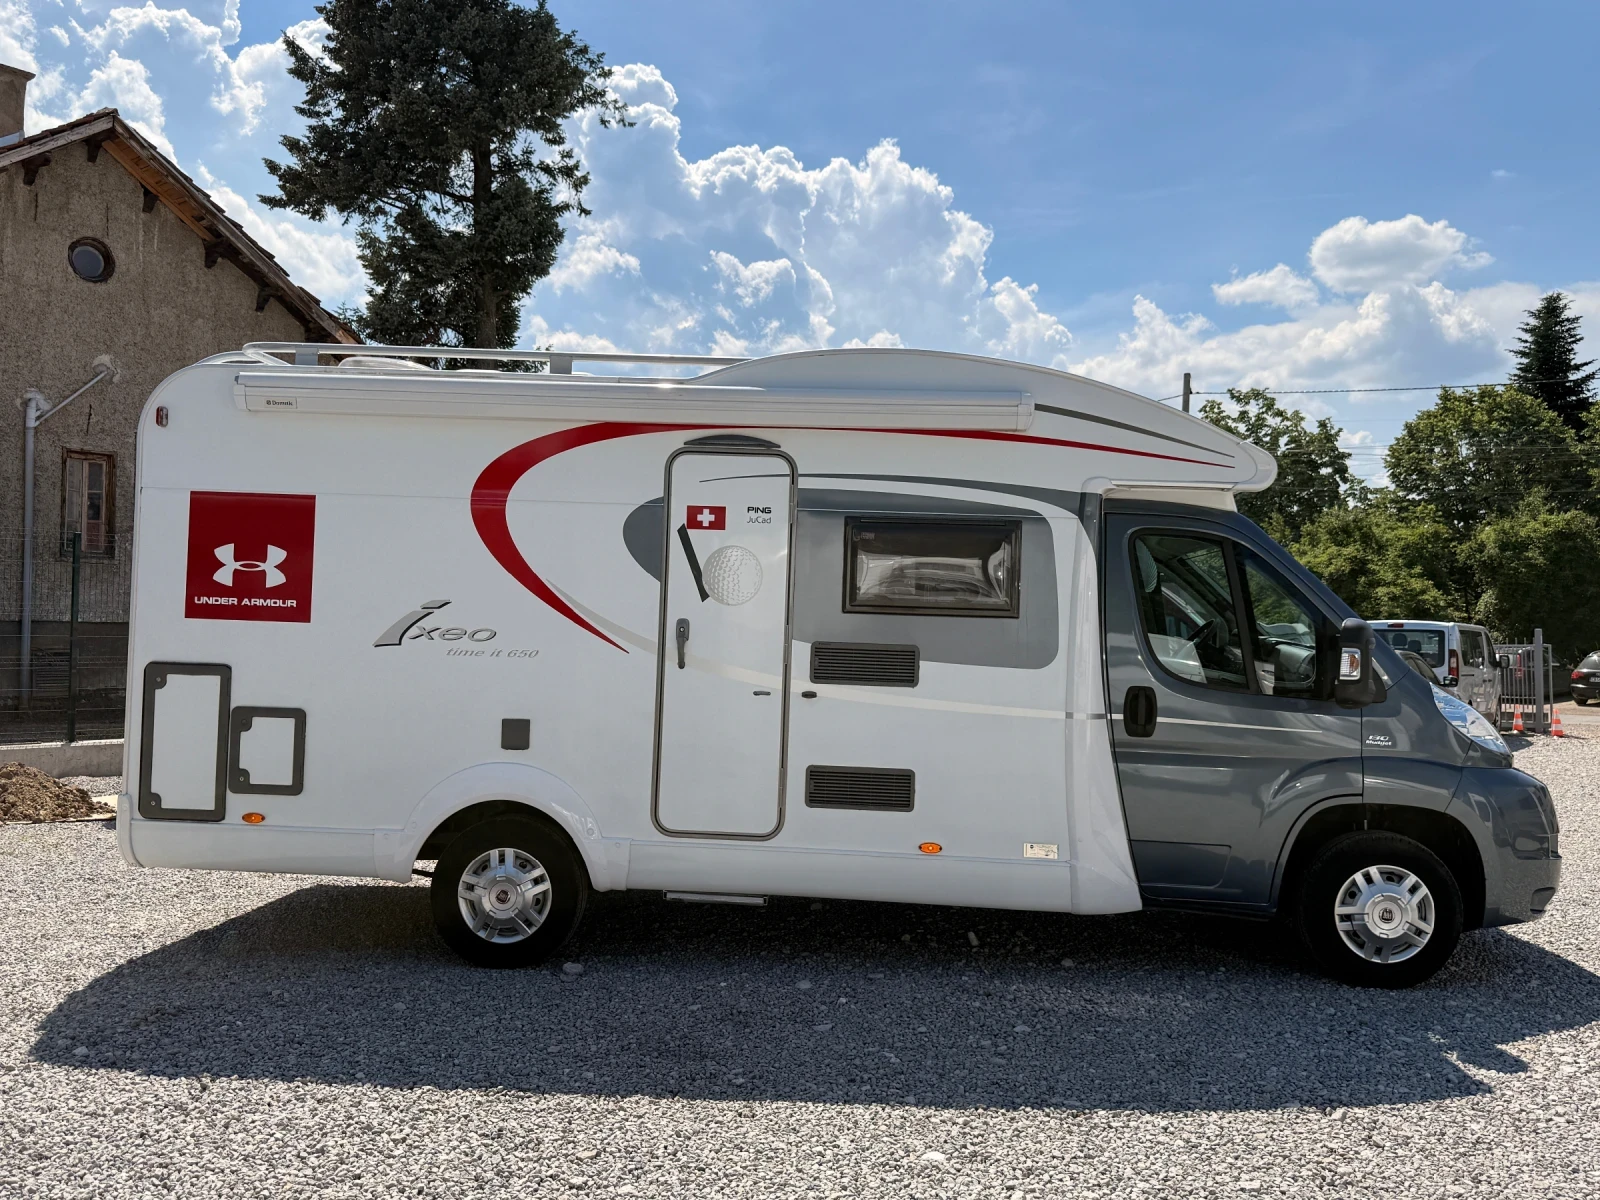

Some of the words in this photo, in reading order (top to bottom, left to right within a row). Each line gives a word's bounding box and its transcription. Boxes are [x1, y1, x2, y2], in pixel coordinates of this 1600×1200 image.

[747, 506, 772, 514] PING
[746, 516, 772, 524] JuCad
[194, 596, 238, 606] UNDER
[241, 598, 297, 608] ARMOUR
[446, 647, 485, 657] time
[489, 648, 503, 658] it
[507, 649, 539, 658] 650
